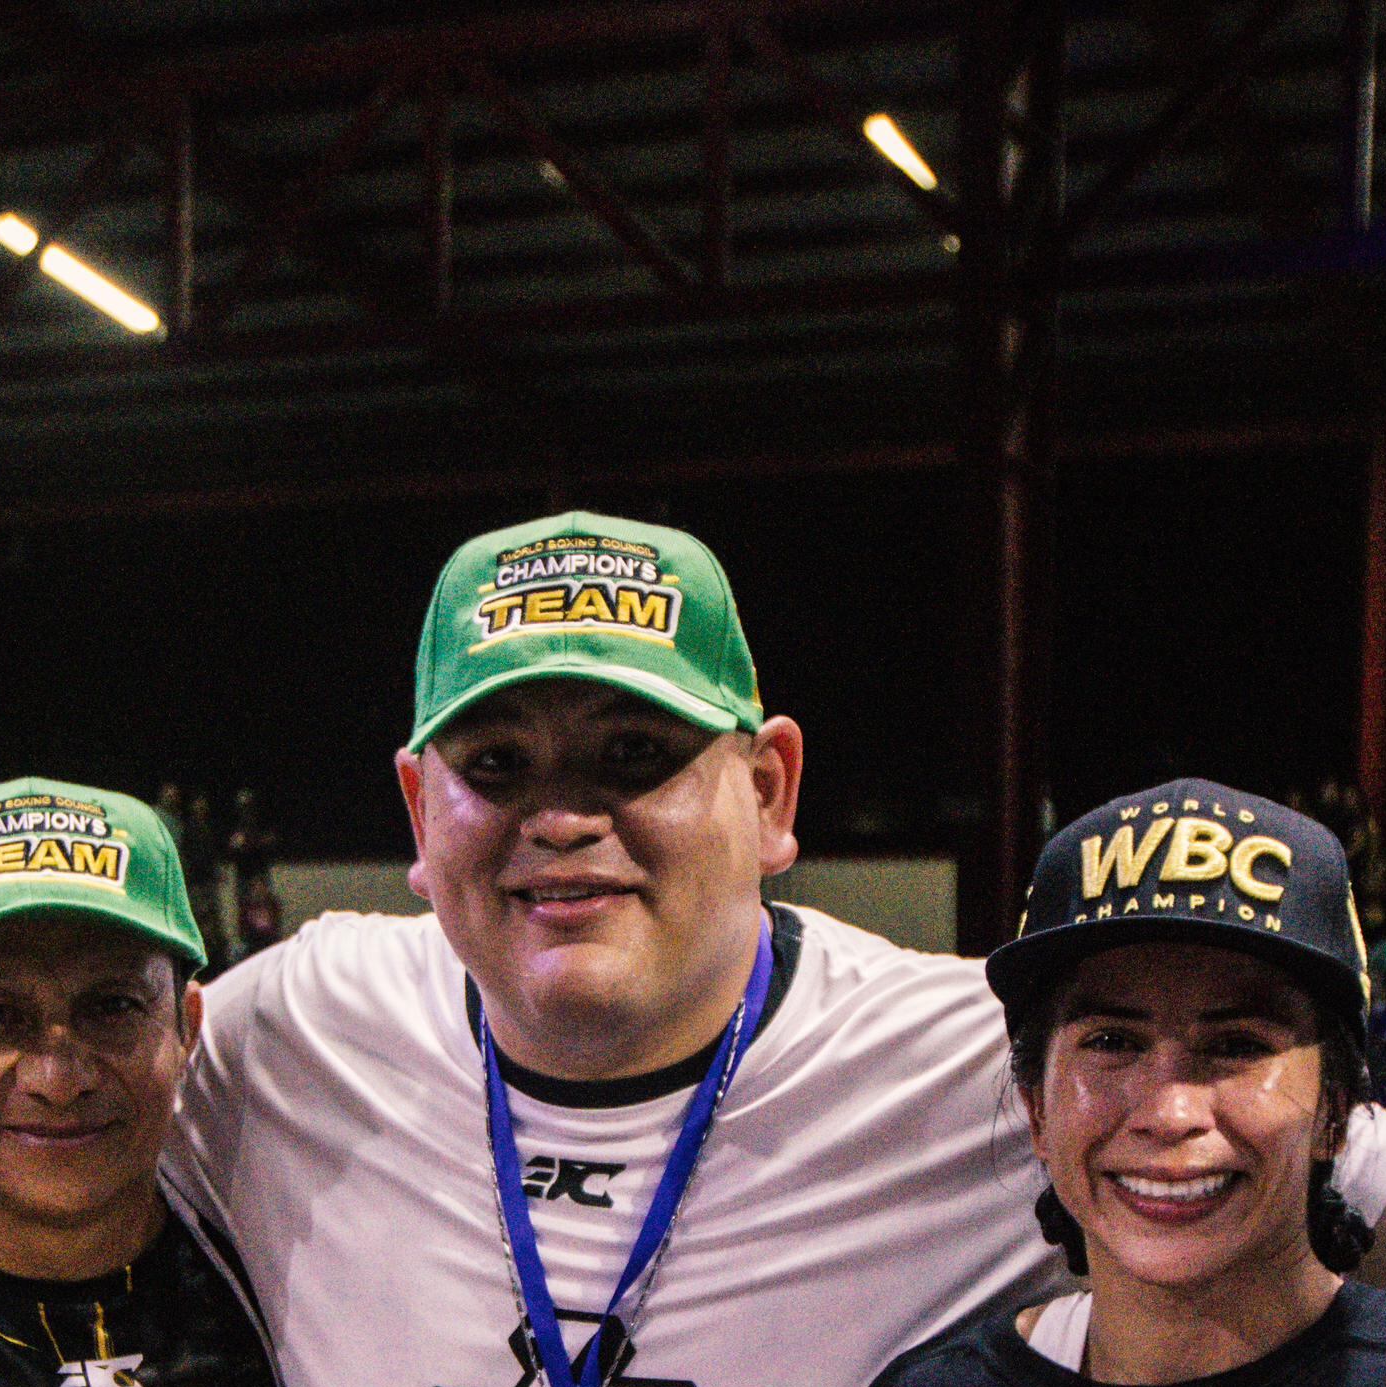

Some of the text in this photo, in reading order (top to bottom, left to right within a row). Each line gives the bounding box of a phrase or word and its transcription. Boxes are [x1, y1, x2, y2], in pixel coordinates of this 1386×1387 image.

[547, 537, 597, 550] BOXING
[601, 537, 657, 559] COUNCIL
[496, 554, 658, 587] CHAMPION'S
[480, 587, 669, 631] TEAM
[5, 797, 51, 810] BOXING
[1120, 799, 1255, 823] WORLD
[1080, 816, 1292, 901] WBC
[1075, 893, 1282, 932] CHAMPION
